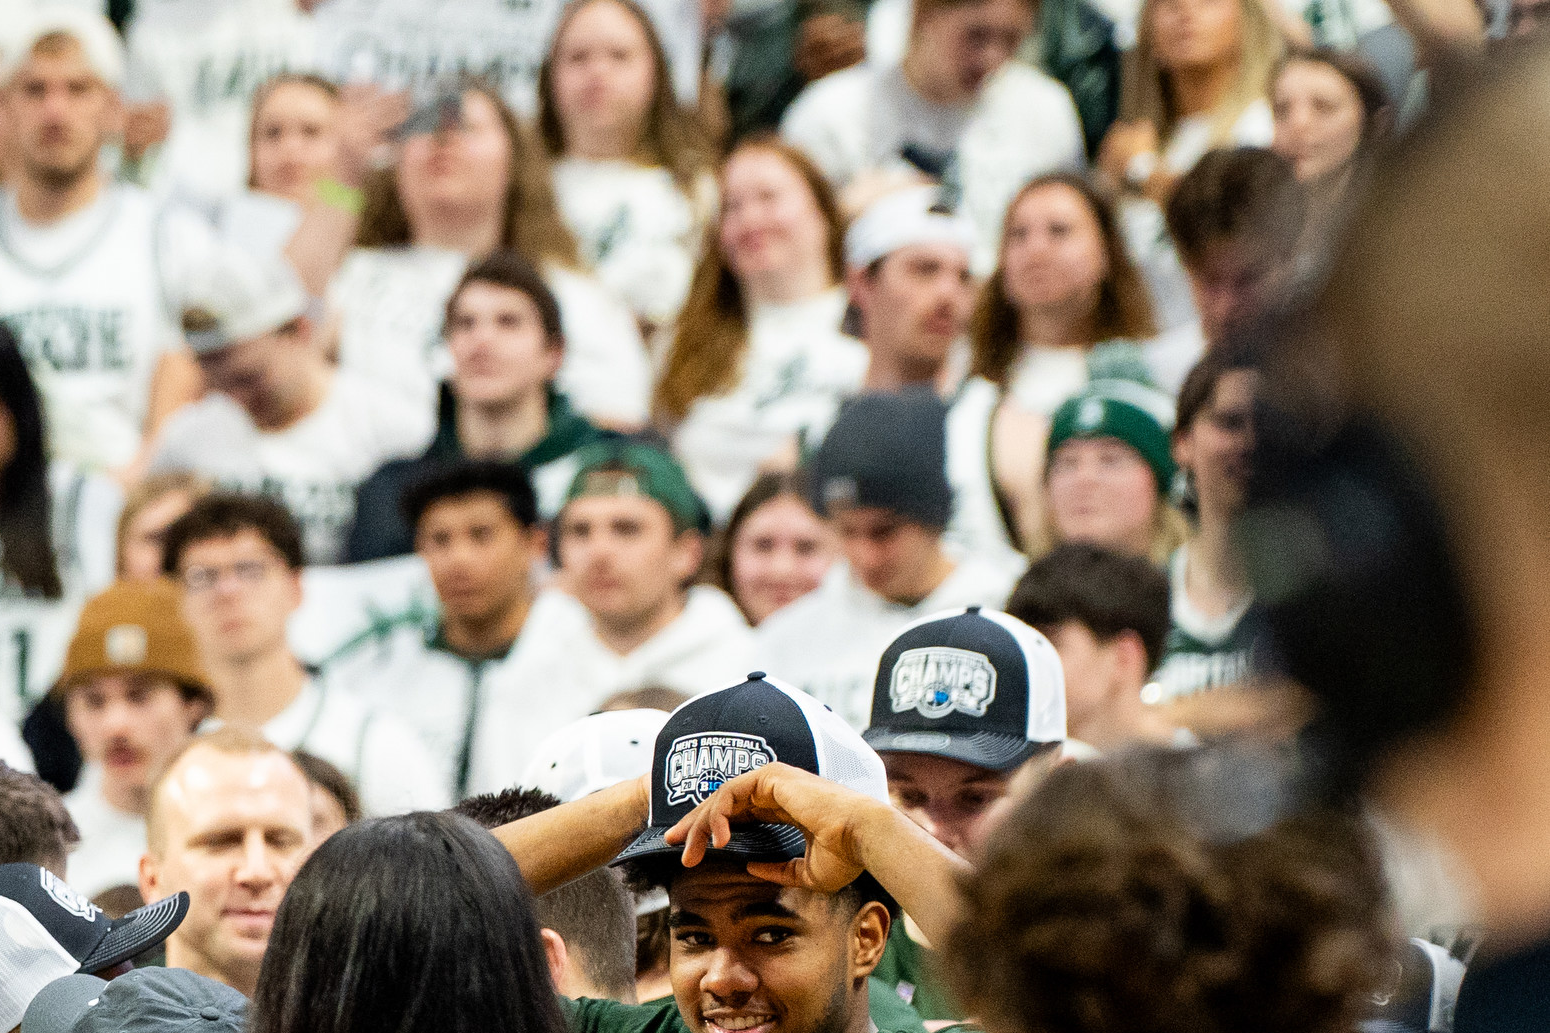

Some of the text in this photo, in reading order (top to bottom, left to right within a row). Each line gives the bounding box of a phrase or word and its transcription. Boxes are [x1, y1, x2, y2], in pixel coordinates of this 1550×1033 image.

[896, 661, 990, 700] CHAMPS
[675, 737, 762, 752] MEN'S BASKETBALL
[669, 746, 770, 787] CHAMPS
